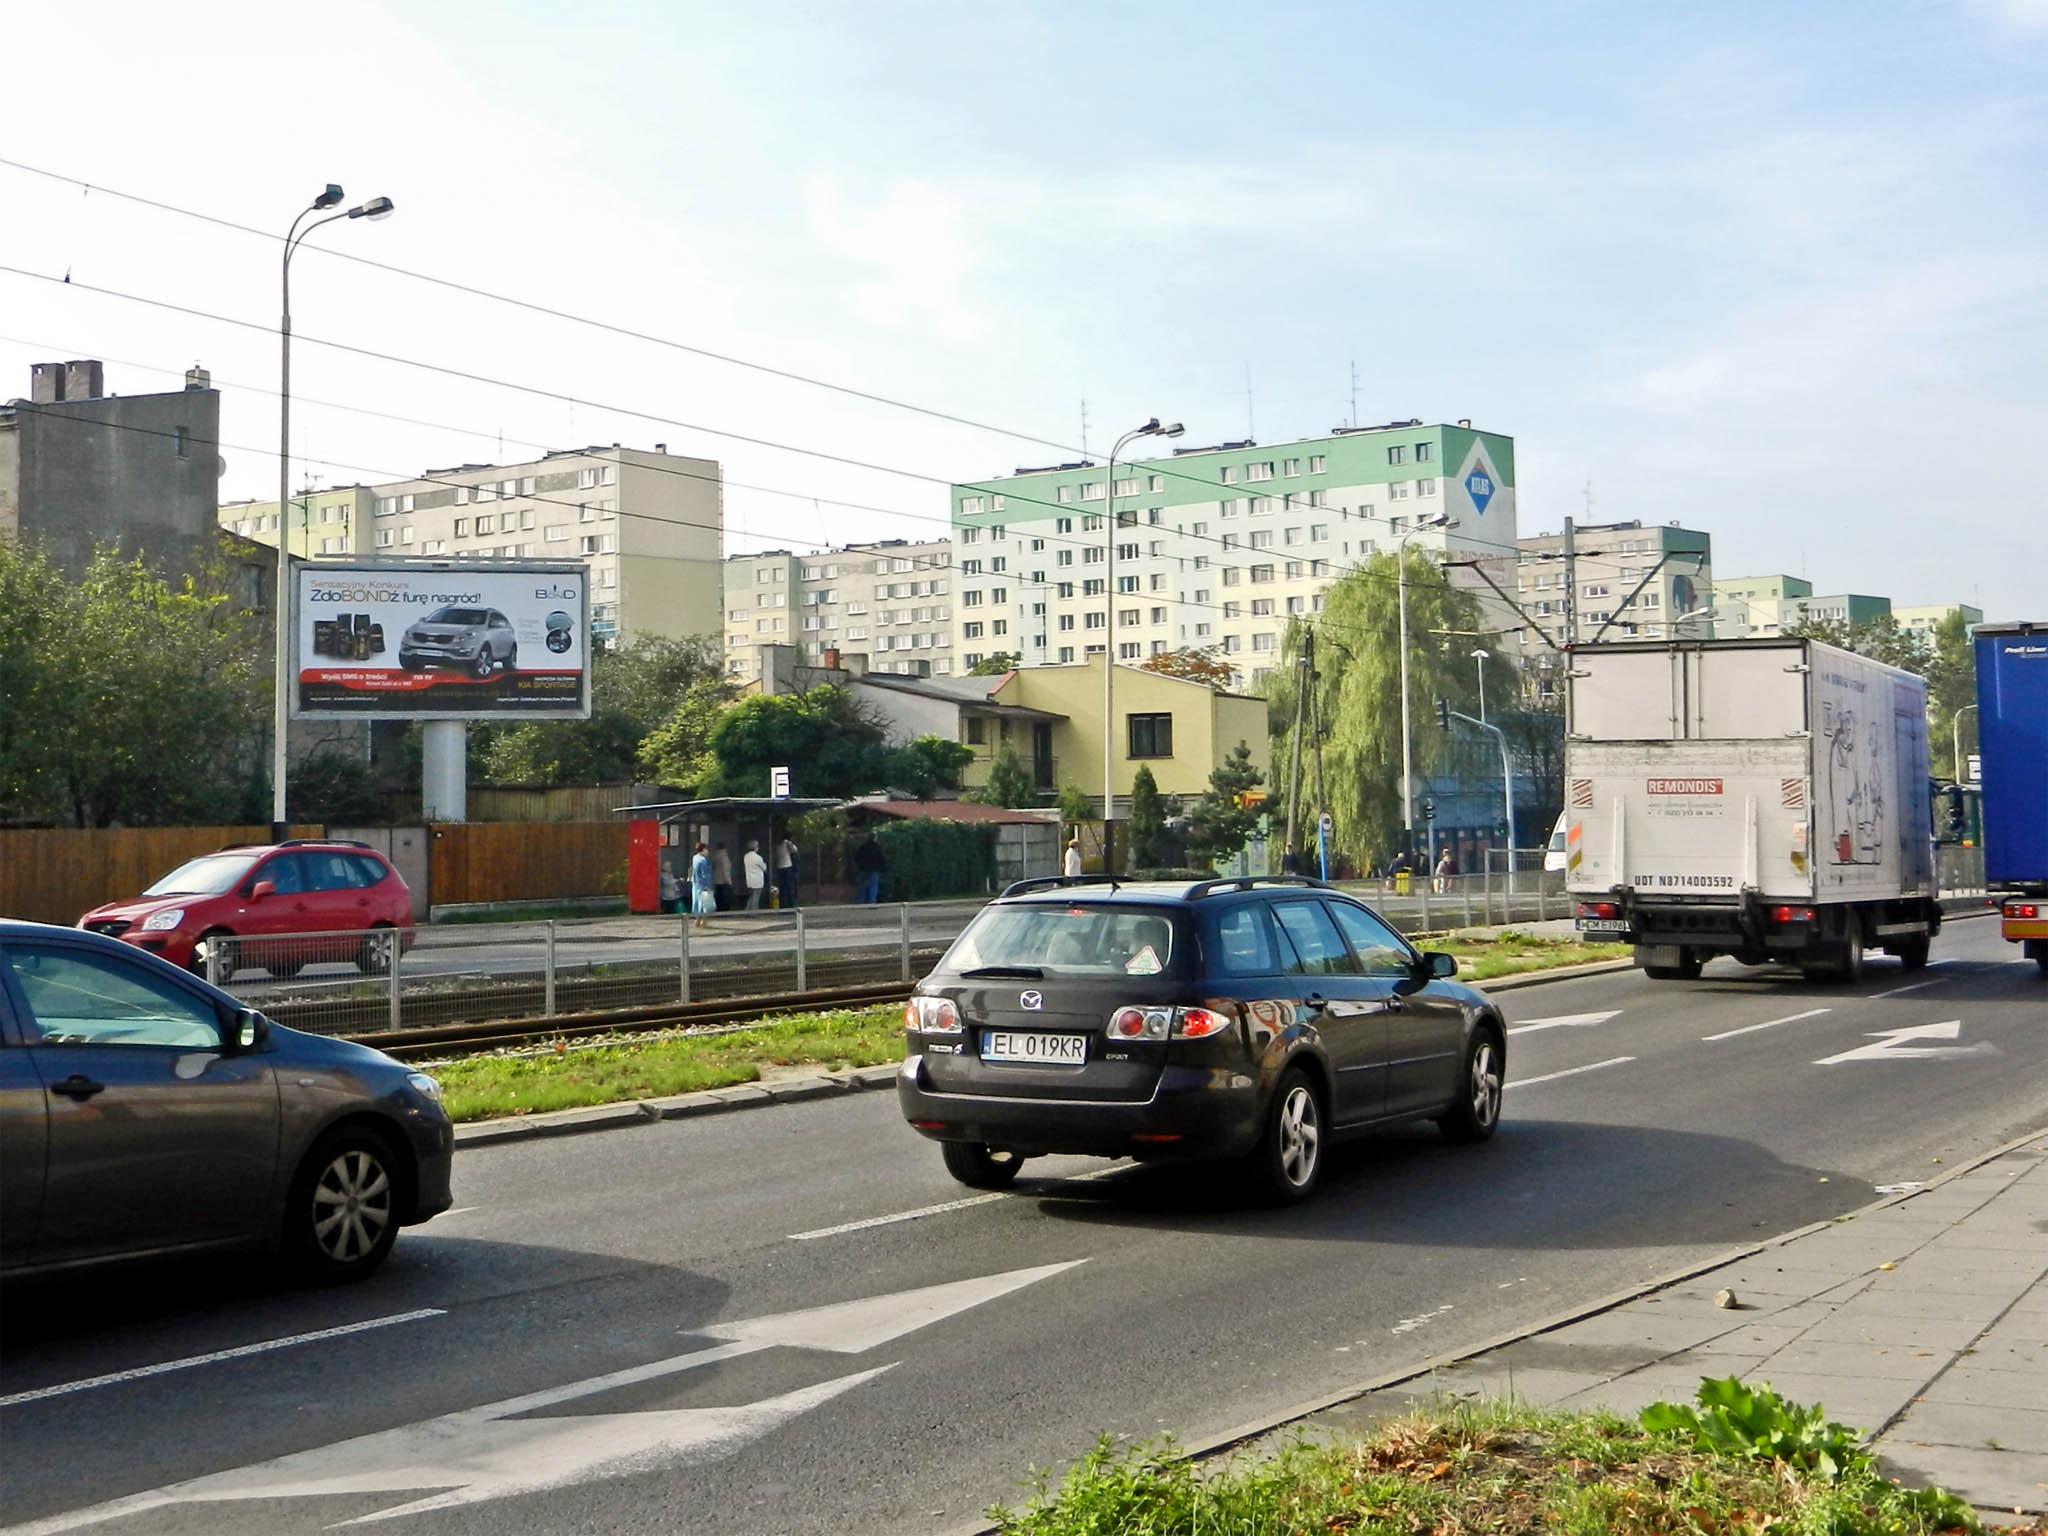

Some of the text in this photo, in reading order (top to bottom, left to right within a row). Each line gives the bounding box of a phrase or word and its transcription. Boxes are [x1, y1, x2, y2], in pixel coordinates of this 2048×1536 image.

[310, 579, 409, 590] Sensacyjny Konkurs
[310, 588, 481, 606] ZdoBONDź furę nagród!
[1648, 780, 1717, 793] REMONDIS
[1659, 876, 1733, 887] N8714003592
[994, 1034, 1083, 1058] EL 019KR
